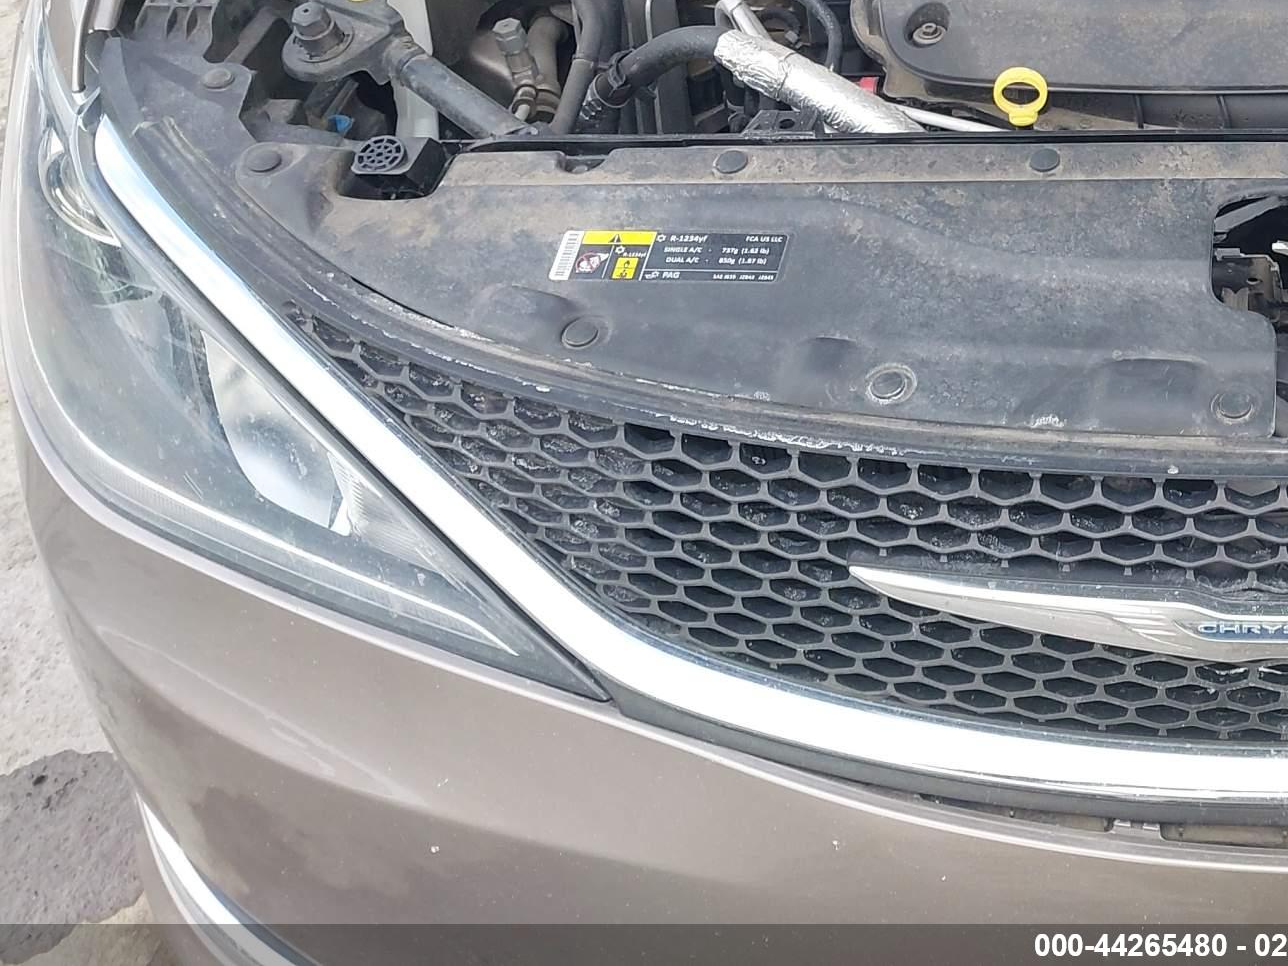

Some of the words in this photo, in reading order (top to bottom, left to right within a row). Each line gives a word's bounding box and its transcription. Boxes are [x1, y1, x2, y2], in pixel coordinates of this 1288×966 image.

[669, 234, 709, 244] R-1234yf
[688, 246, 702, 254] A/C
[662, 271, 681, 279] PAG
